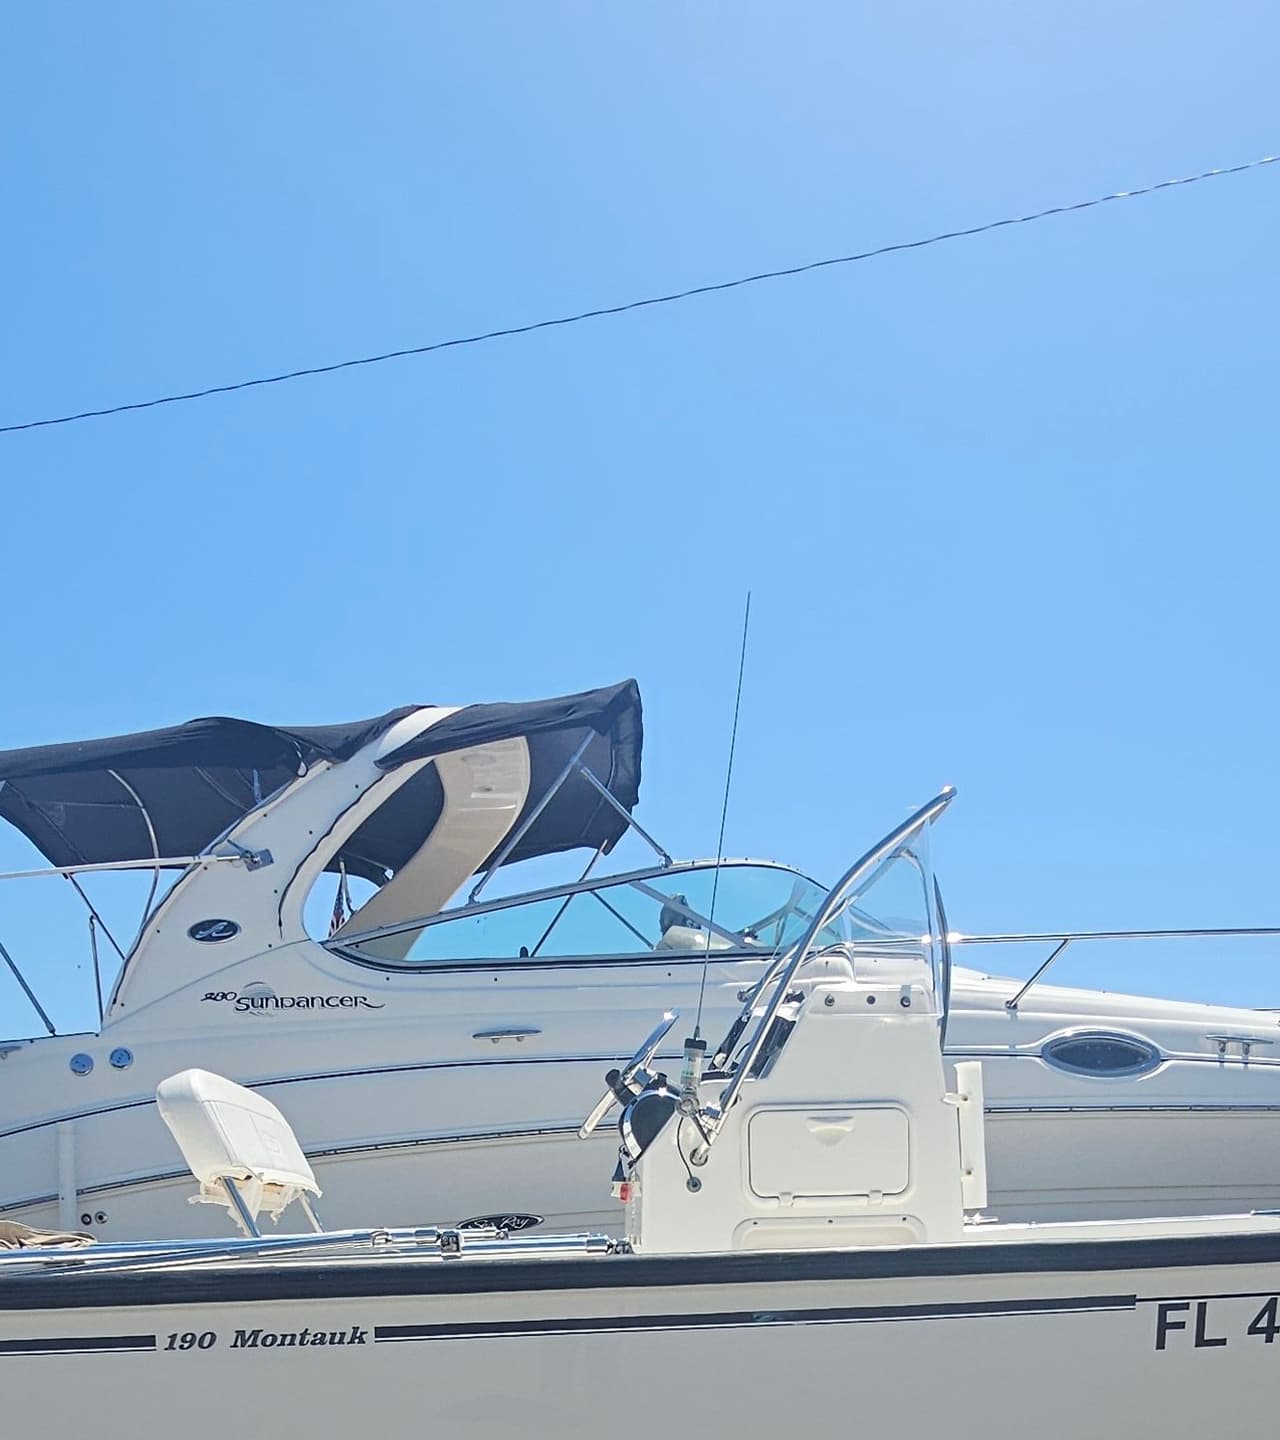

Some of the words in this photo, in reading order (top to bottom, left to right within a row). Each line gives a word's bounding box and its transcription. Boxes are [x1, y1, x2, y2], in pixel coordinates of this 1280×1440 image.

[500, 1215, 530, 1230] Ray
[164, 1331, 217, 1351] 190
[230, 1326, 368, 1348] Montauk
[1155, 1302, 1227, 1350] FL
